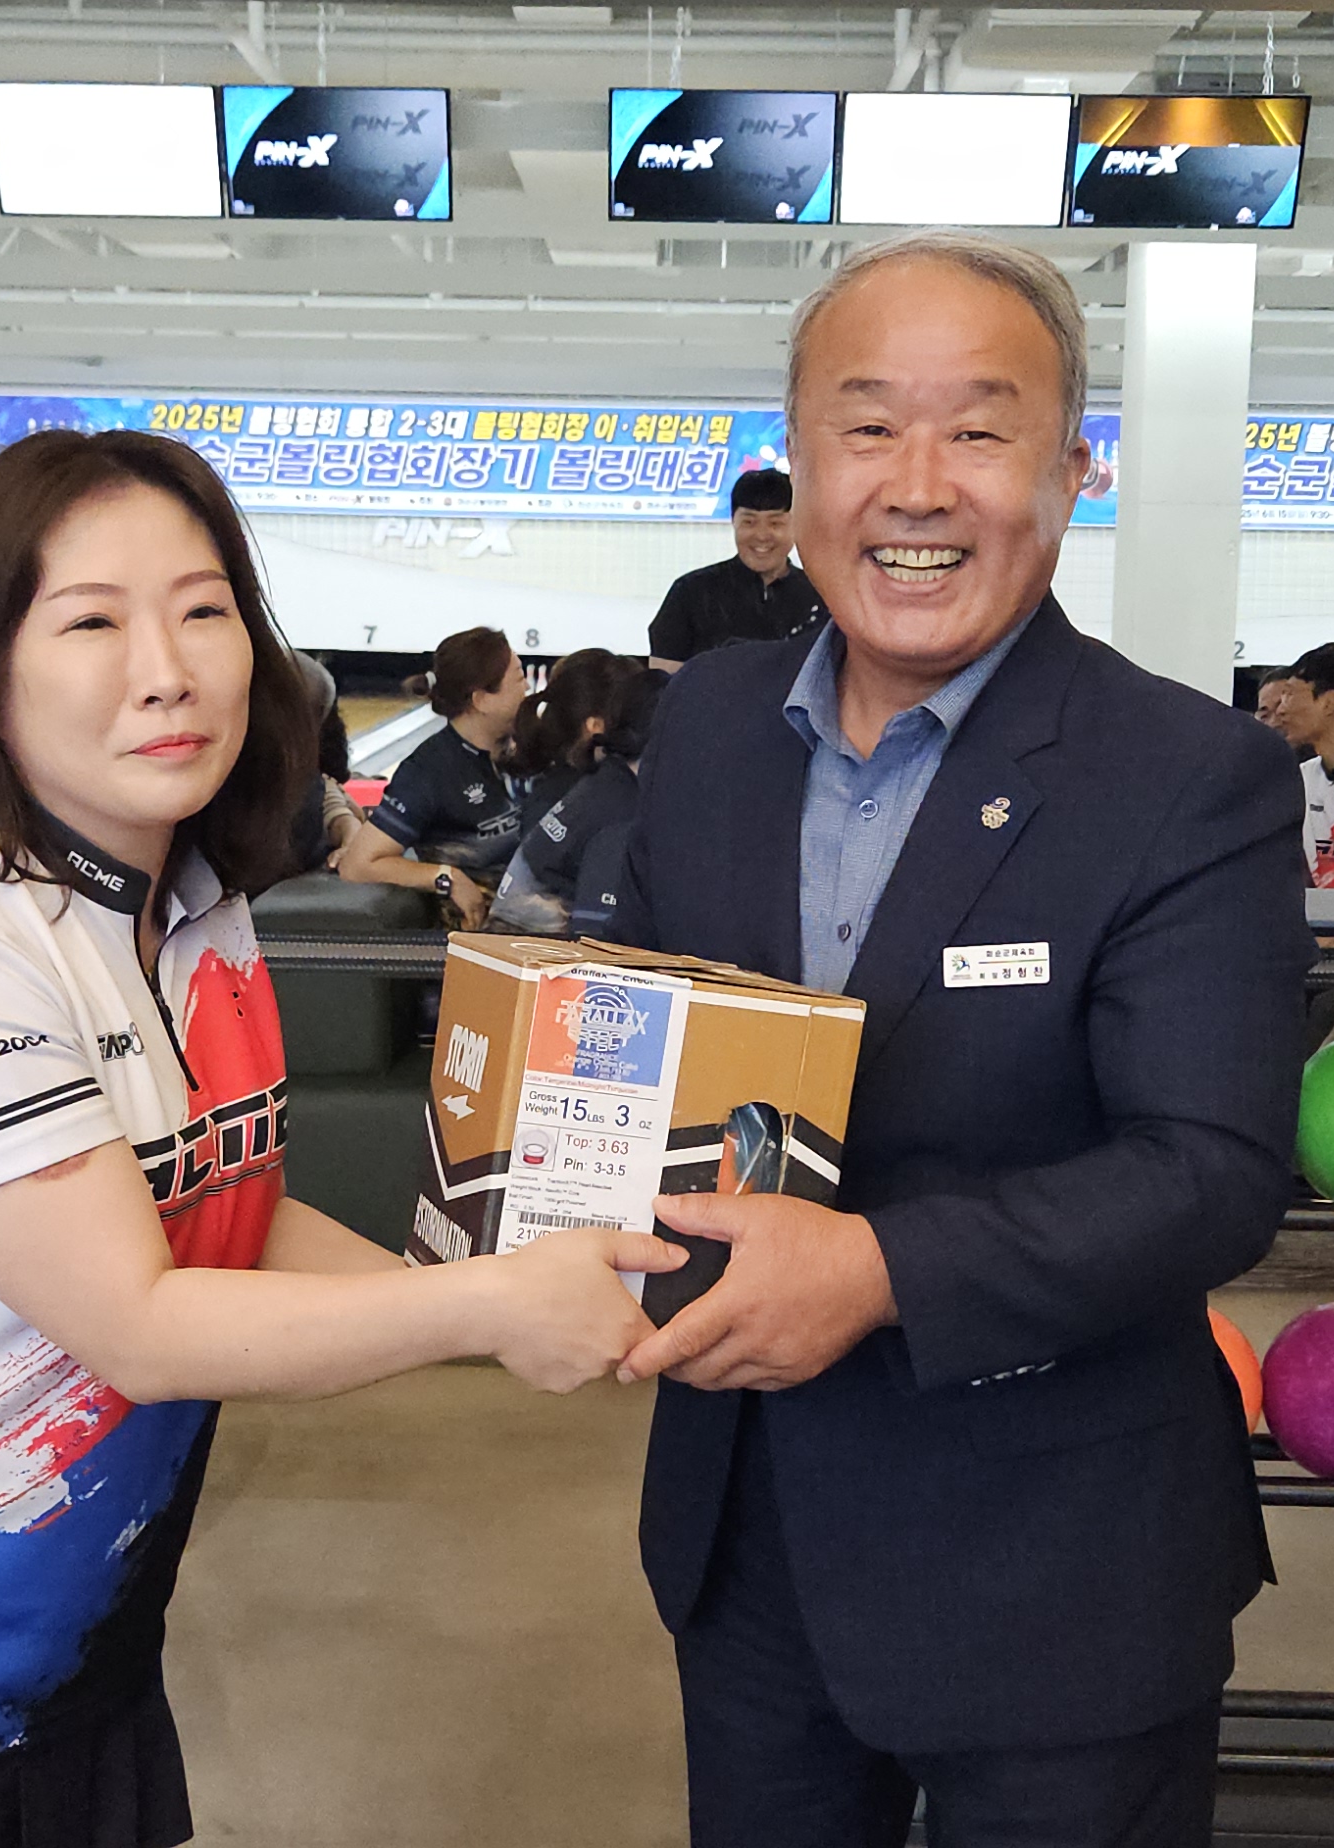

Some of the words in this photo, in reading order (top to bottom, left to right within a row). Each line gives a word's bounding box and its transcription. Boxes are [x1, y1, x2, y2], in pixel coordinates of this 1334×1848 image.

[255, 134, 338, 168] PIN-X
[638, 137, 724, 171] PIN-X
[1103, 143, 1190, 176] PIN-X
[149, 403, 244, 433] 2025년
[248, 405, 341, 437] 볼링협회
[345, 407, 394, 438] 통합
[397, 409, 468, 439] 2-3대
[473, 411, 589, 441] 볼링협회장
[708, 415, 733, 444] 및
[547, 443, 730, 492] 볼링대회
[363, 626, 377, 645] 7
[525, 629, 540, 648] 8
[67, 850, 126, 892] ACME
[443, 1023, 489, 1093] STORM
[525, 1102, 558, 1116] Weight
[559, 1096, 589, 1121] 15
[587, 1114, 605, 1124] LBS
[614, 1104, 630, 1127] 3
[529, 1090, 558, 1103] Gross
[565, 1134, 593, 1150] Top:
[597, 1138, 629, 1155] 3.63
[563, 1158, 587, 1171] Pin:
[593, 1161, 627, 1177] 3-3.5
